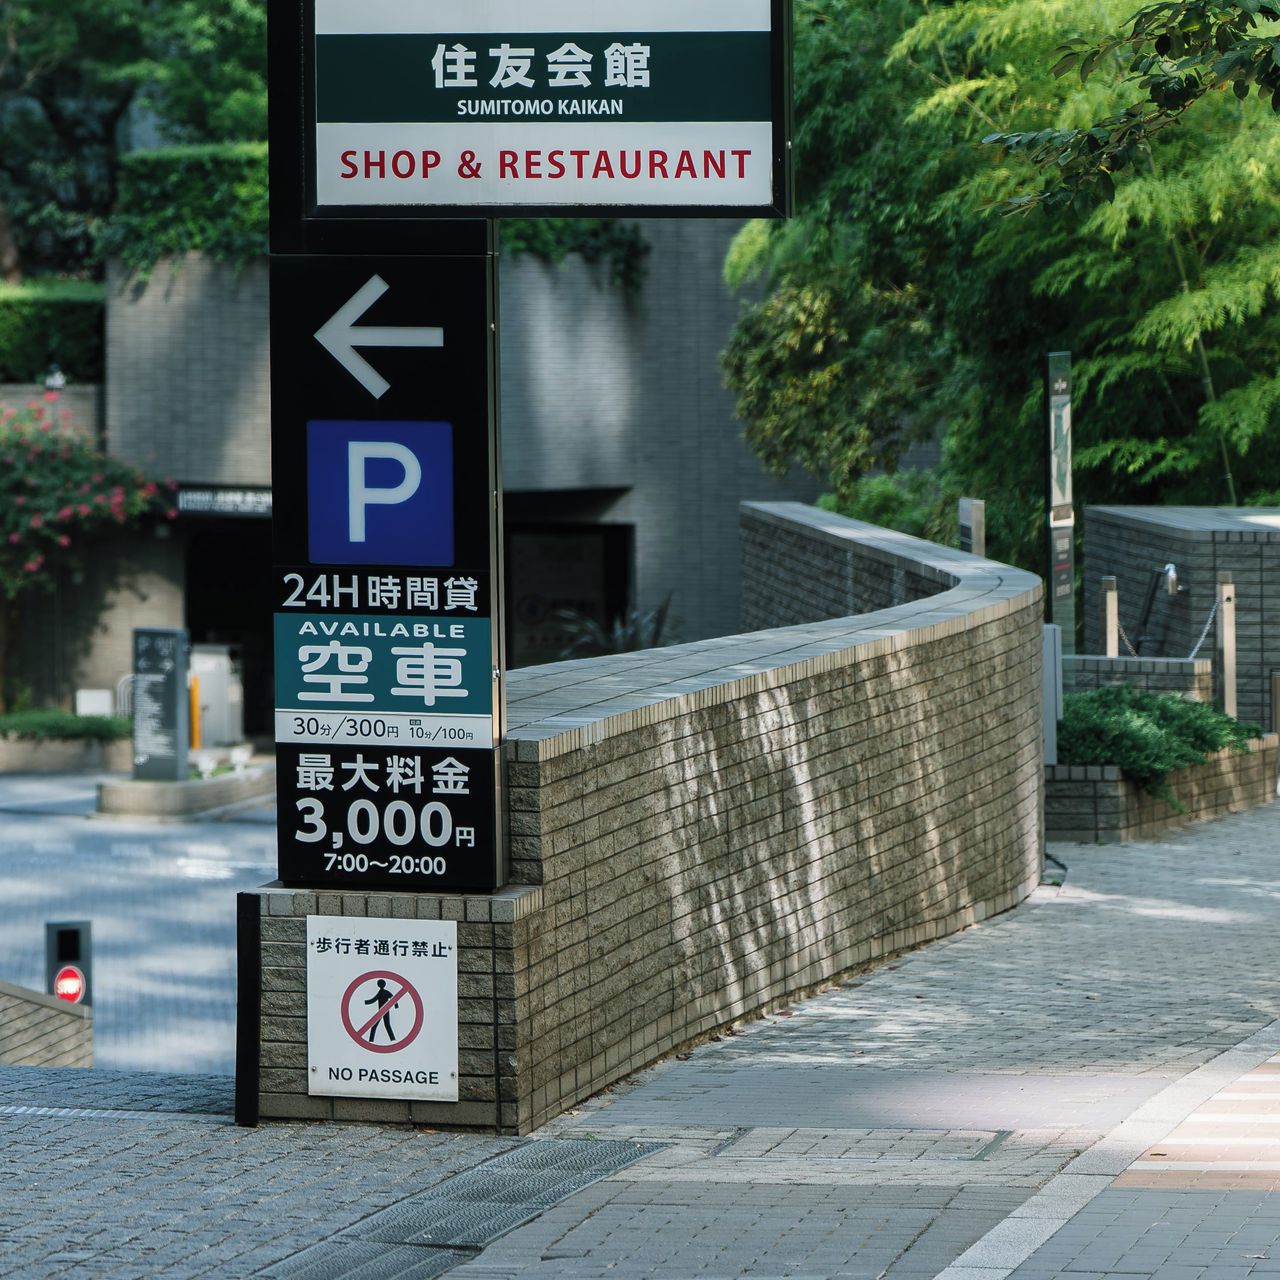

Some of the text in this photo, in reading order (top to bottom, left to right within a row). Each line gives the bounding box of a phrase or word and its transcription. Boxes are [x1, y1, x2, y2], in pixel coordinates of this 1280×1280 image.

[431, 42, 651, 89] 住友会館
[457, 99, 624, 115] SUMITOMO KAIKAN
[340, 149, 752, 179] SHOP & RESTAURANT
[348, 441, 422, 543] P
[282, 573, 479, 612] 24H時間貸
[298, 621, 466, 639] AVAILABLE
[297, 640, 469, 707] 空車
[296, 753, 470, 795] 最大料金
[294, 797, 476, 849] 3,000円
[316, 936, 448, 958] 歩行者通行禁止
[328, 1067, 440, 1085] NO PASSAGE
